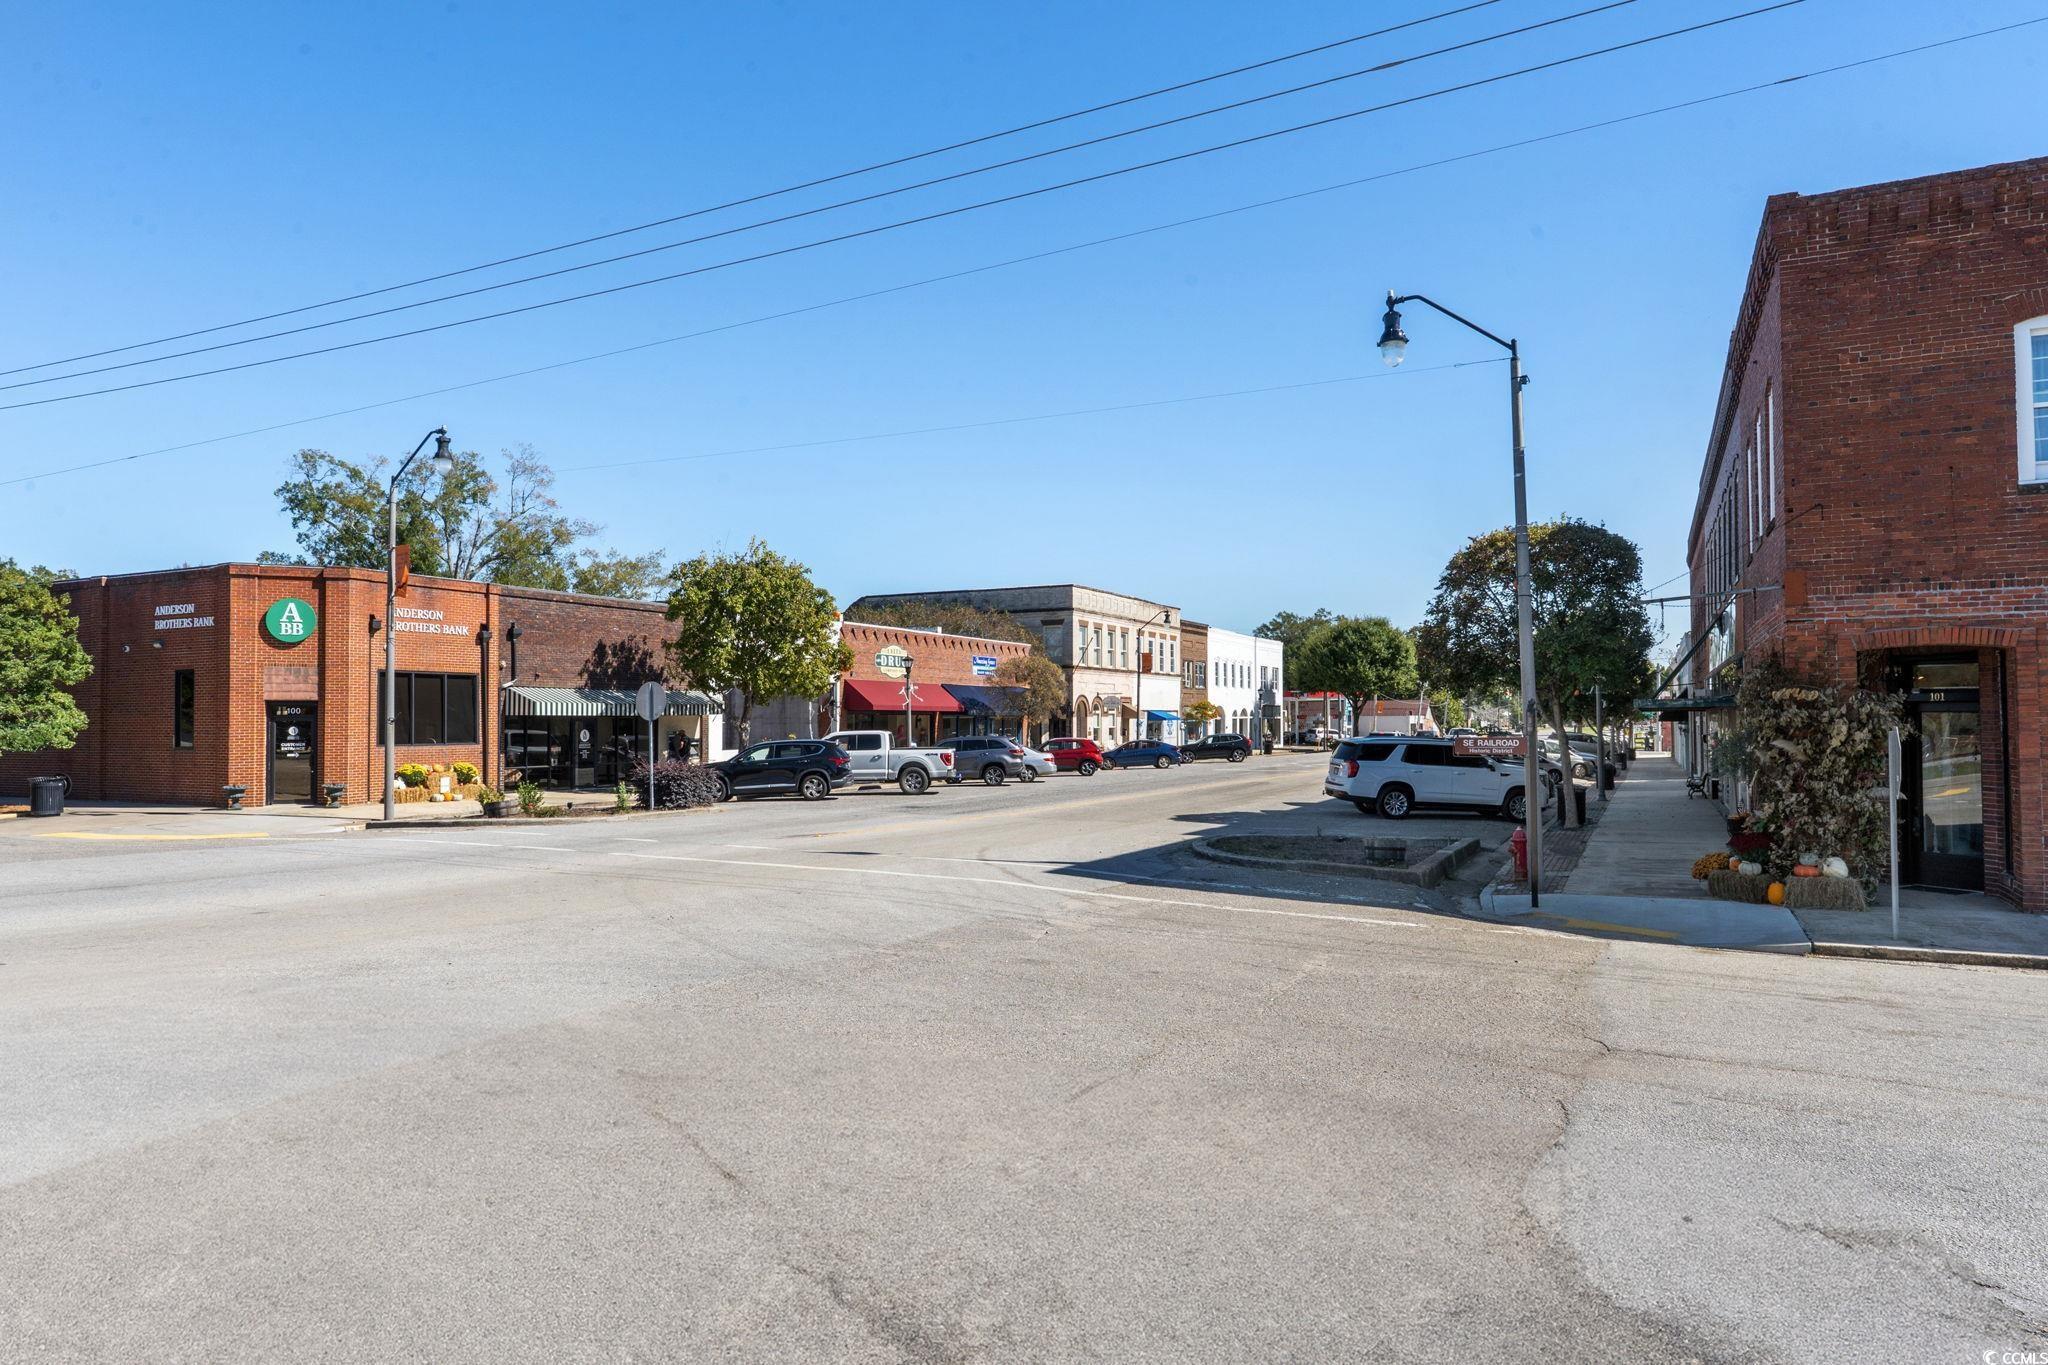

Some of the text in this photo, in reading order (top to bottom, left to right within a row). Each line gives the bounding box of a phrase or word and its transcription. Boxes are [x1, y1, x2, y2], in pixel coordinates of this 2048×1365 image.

[154, 603, 195, 616] ANDERSON
[279, 602, 304, 622] A
[394, 607, 443, 620] NDERSON
[154, 616, 215, 630] BROTHERS BANK
[279, 622, 304, 636] BB
[394, 620, 469, 636] ROTHERS BANK
[1930, 692, 1945, 702] 101
[287, 707, 302, 715] 100
[1463, 739, 1520, 747] SE RAILROAD
